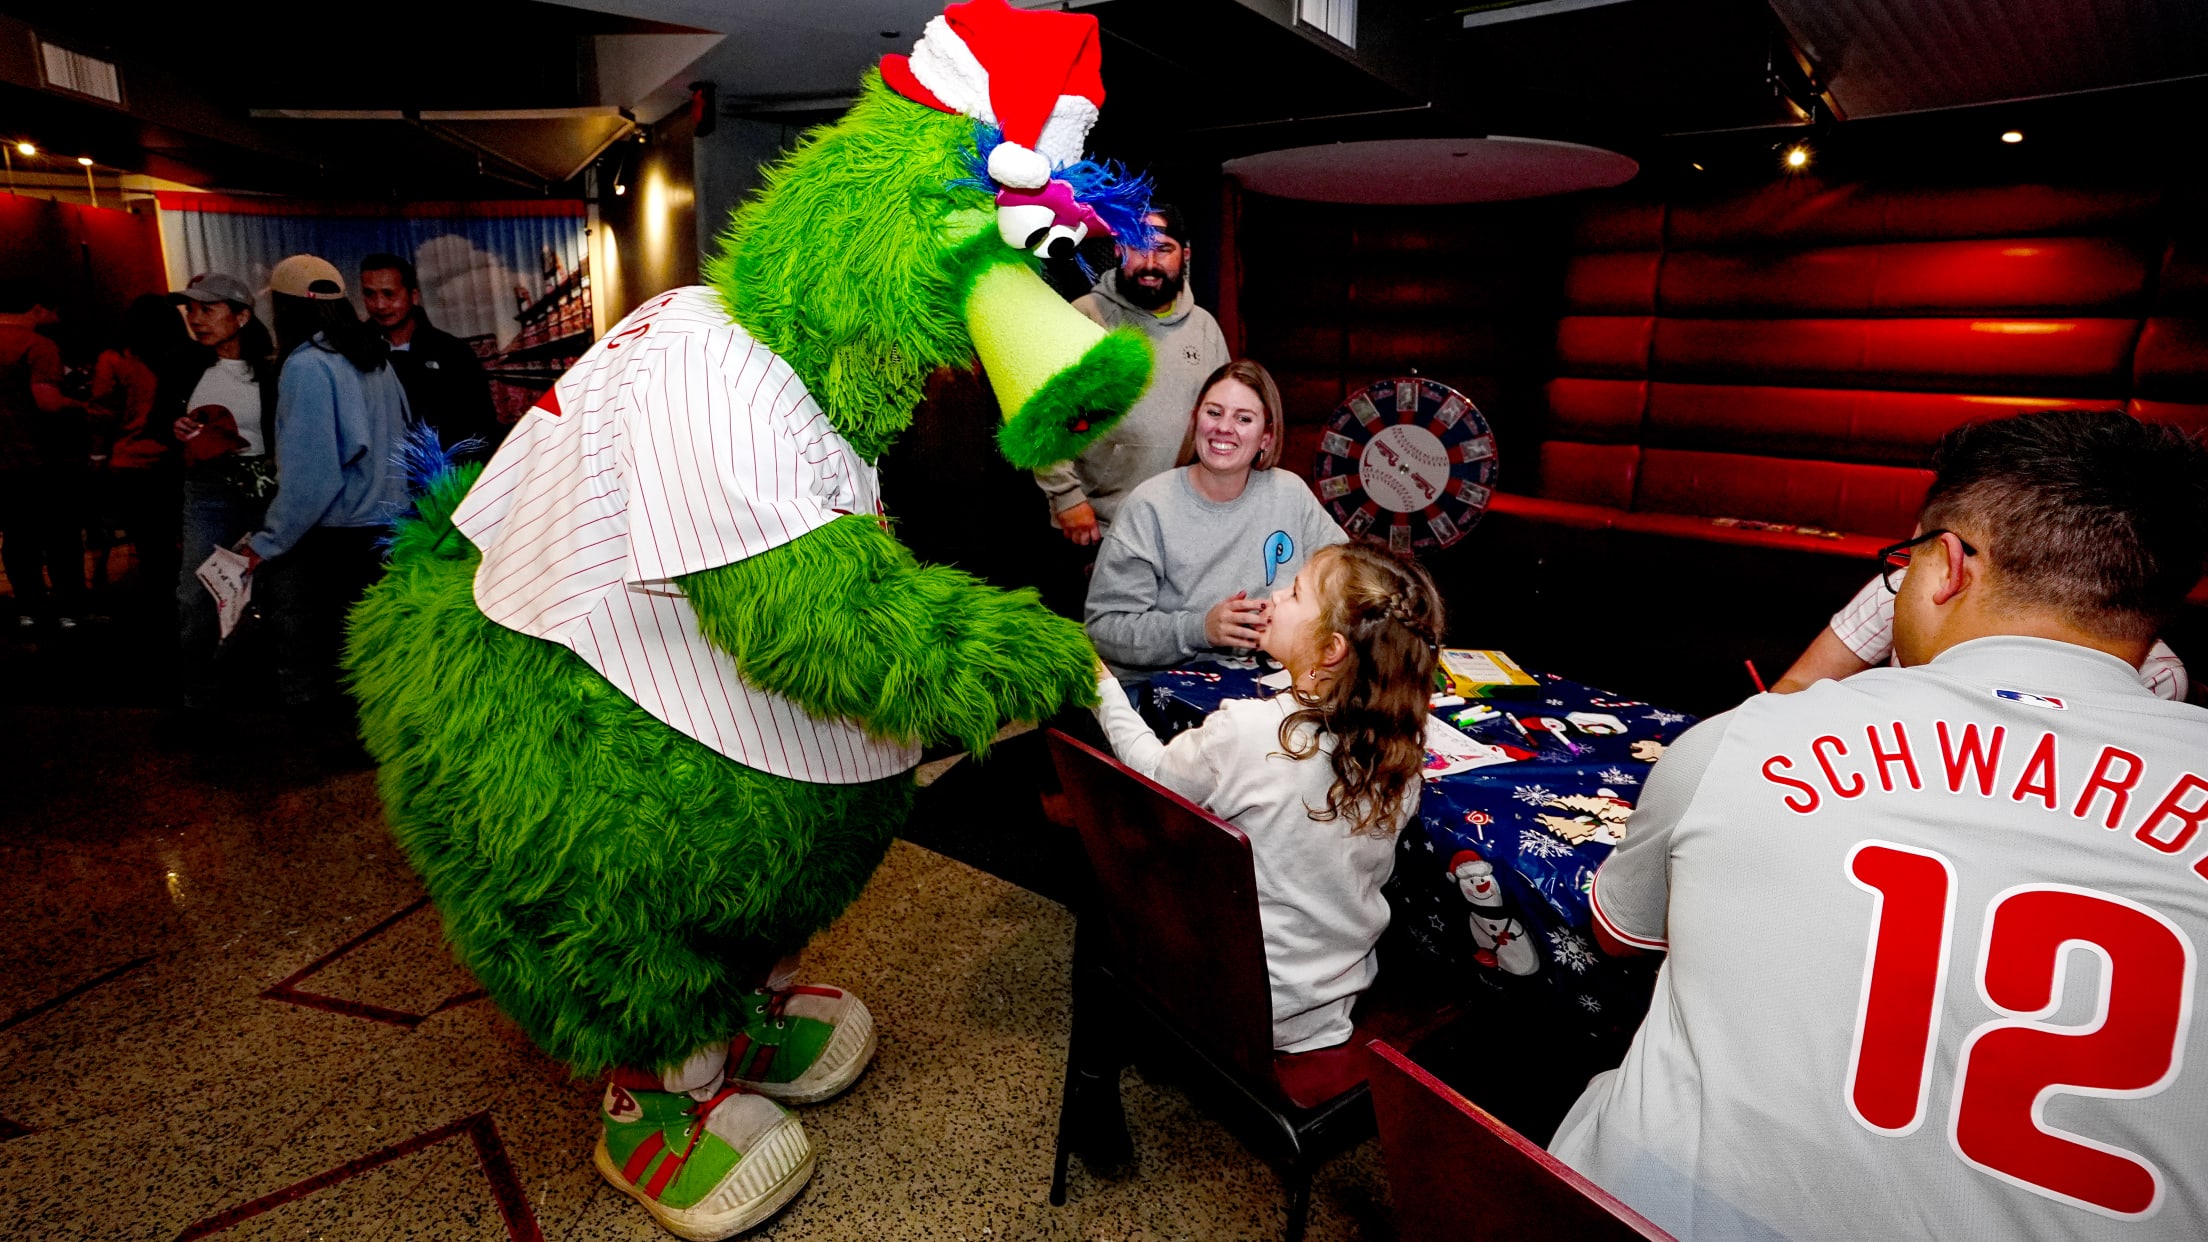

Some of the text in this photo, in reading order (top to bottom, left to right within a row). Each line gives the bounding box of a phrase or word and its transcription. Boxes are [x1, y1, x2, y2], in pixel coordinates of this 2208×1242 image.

[1264, 531, 1294, 586] P
[1761, 720, 2208, 882] SCHWARB
[1845, 839, 2197, 1222] 12
[610, 1086, 636, 1116] P
